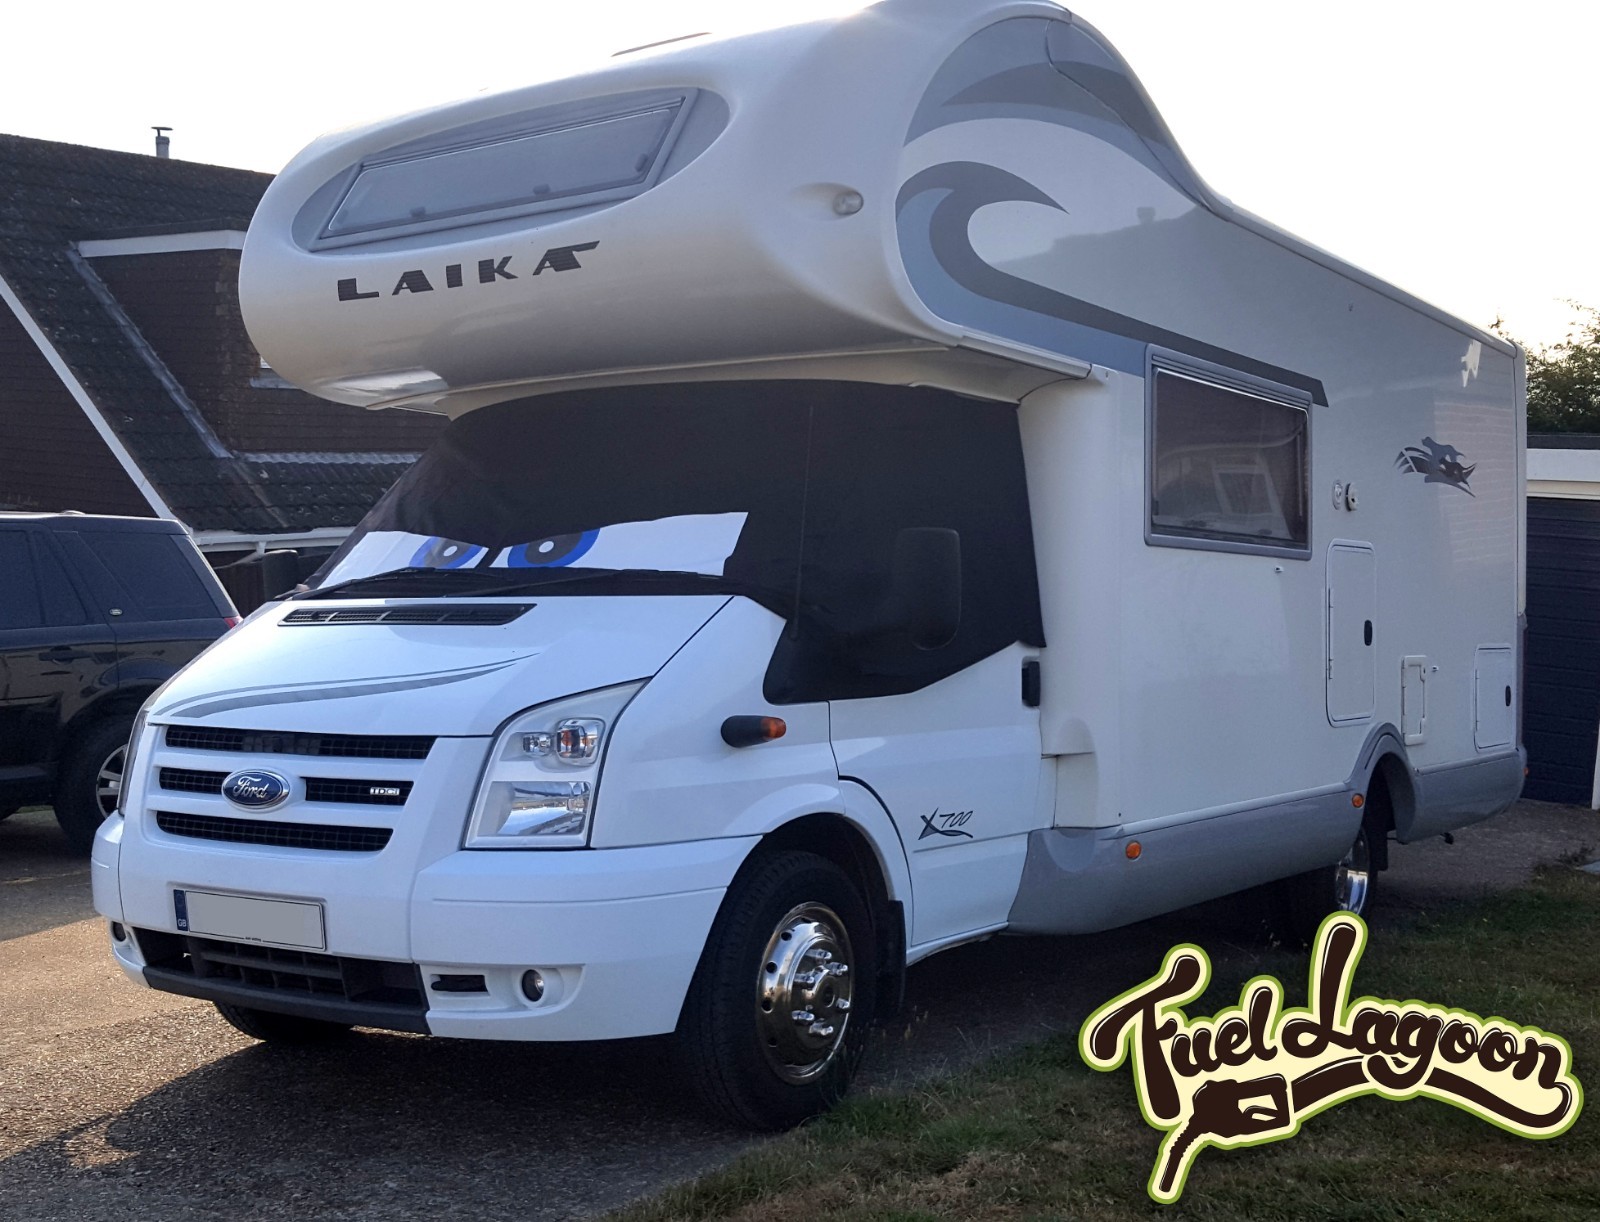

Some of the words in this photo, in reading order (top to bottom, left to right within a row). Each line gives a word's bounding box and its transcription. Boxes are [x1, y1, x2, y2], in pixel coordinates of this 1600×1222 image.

[337, 240, 600, 301] LAIKA
[233, 776, 269, 798] Ford
[918, 807, 973, 839] X700
[178, 918, 187, 927] GB
